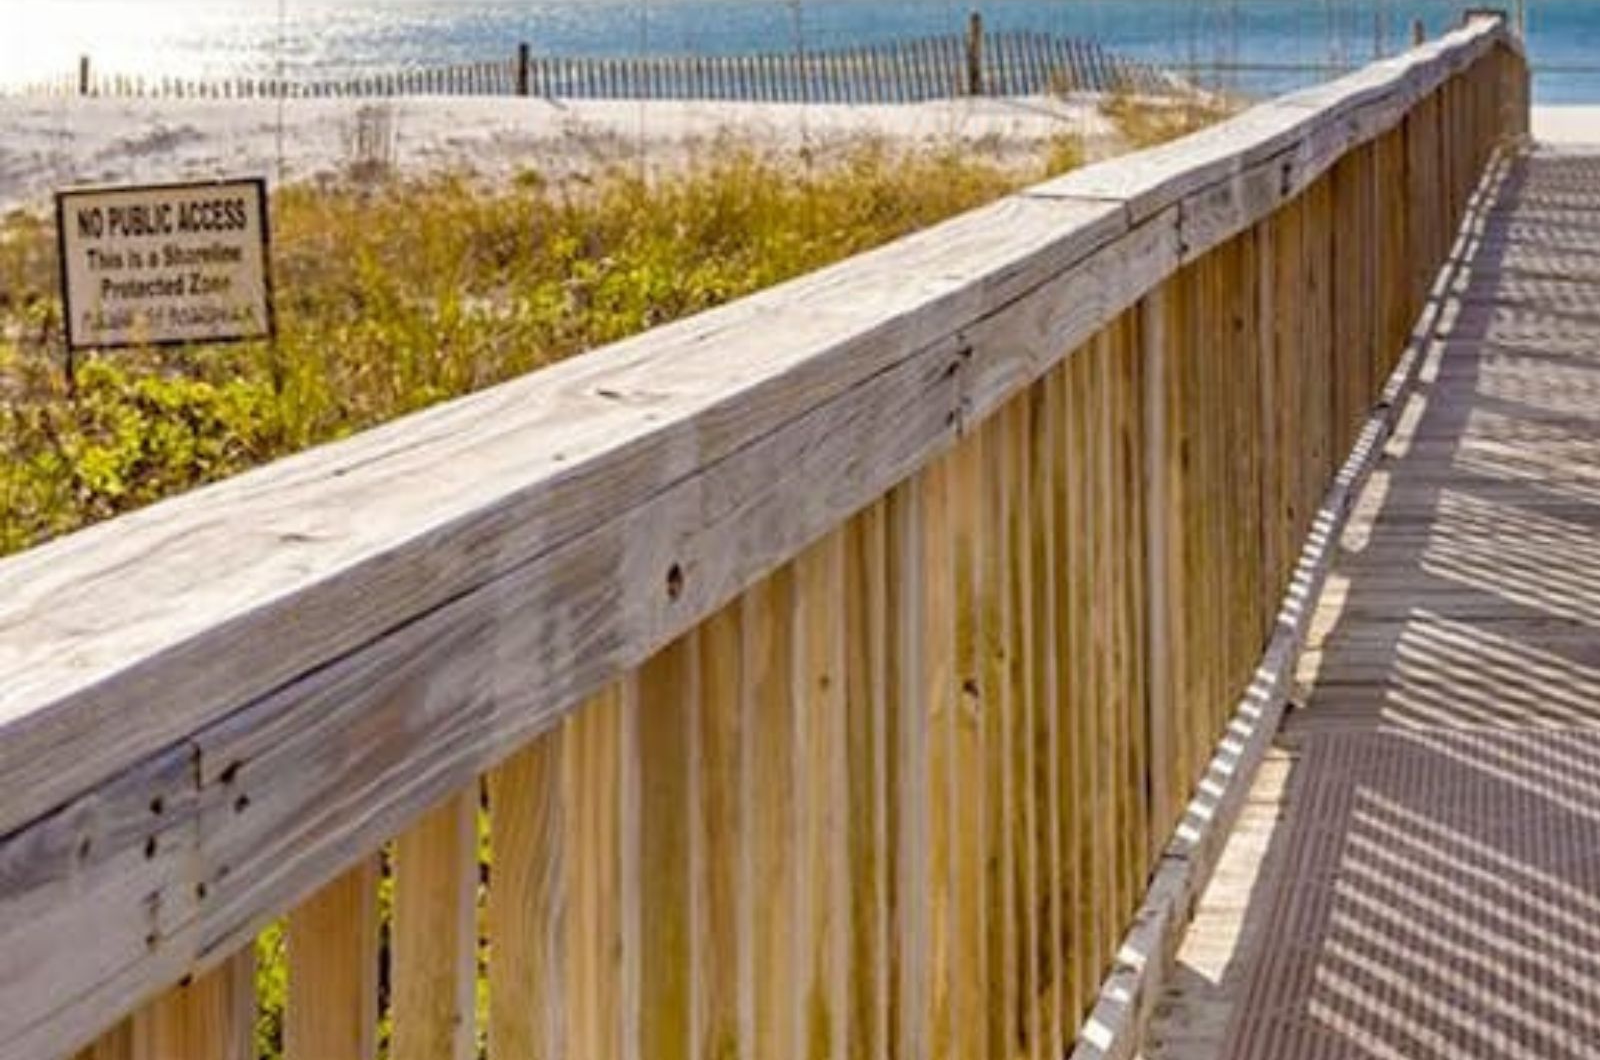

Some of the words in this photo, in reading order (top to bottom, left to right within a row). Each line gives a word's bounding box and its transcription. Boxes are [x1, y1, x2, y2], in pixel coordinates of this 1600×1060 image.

[77, 206, 103, 239] NO
[108, 203, 172, 236] PUBLIC
[178, 197, 247, 232] ACCESS
[87, 247, 123, 271] This
[128, 248, 142, 268] is
[149, 251, 159, 268] a
[162, 242, 242, 267] Shoreline
[101, 273, 184, 299] Protected
[189, 271, 231, 295] Zone
